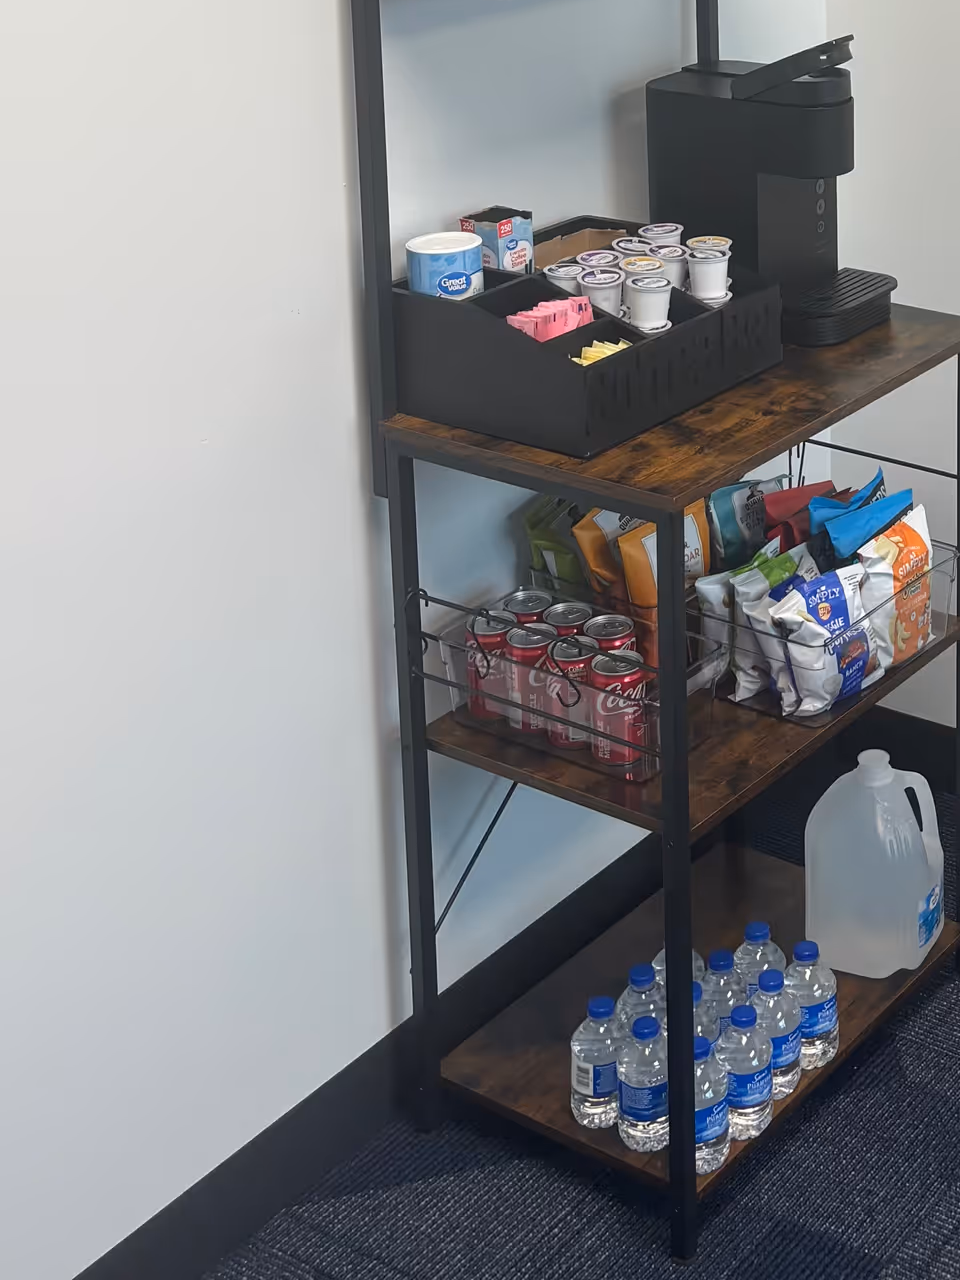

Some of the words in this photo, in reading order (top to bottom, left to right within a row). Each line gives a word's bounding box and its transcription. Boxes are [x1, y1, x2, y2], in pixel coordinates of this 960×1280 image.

[462, 222, 474, 231] 250
[500, 223, 512, 234] 250
[441, 276, 467, 287] Great
[448, 283, 467, 291] Value
